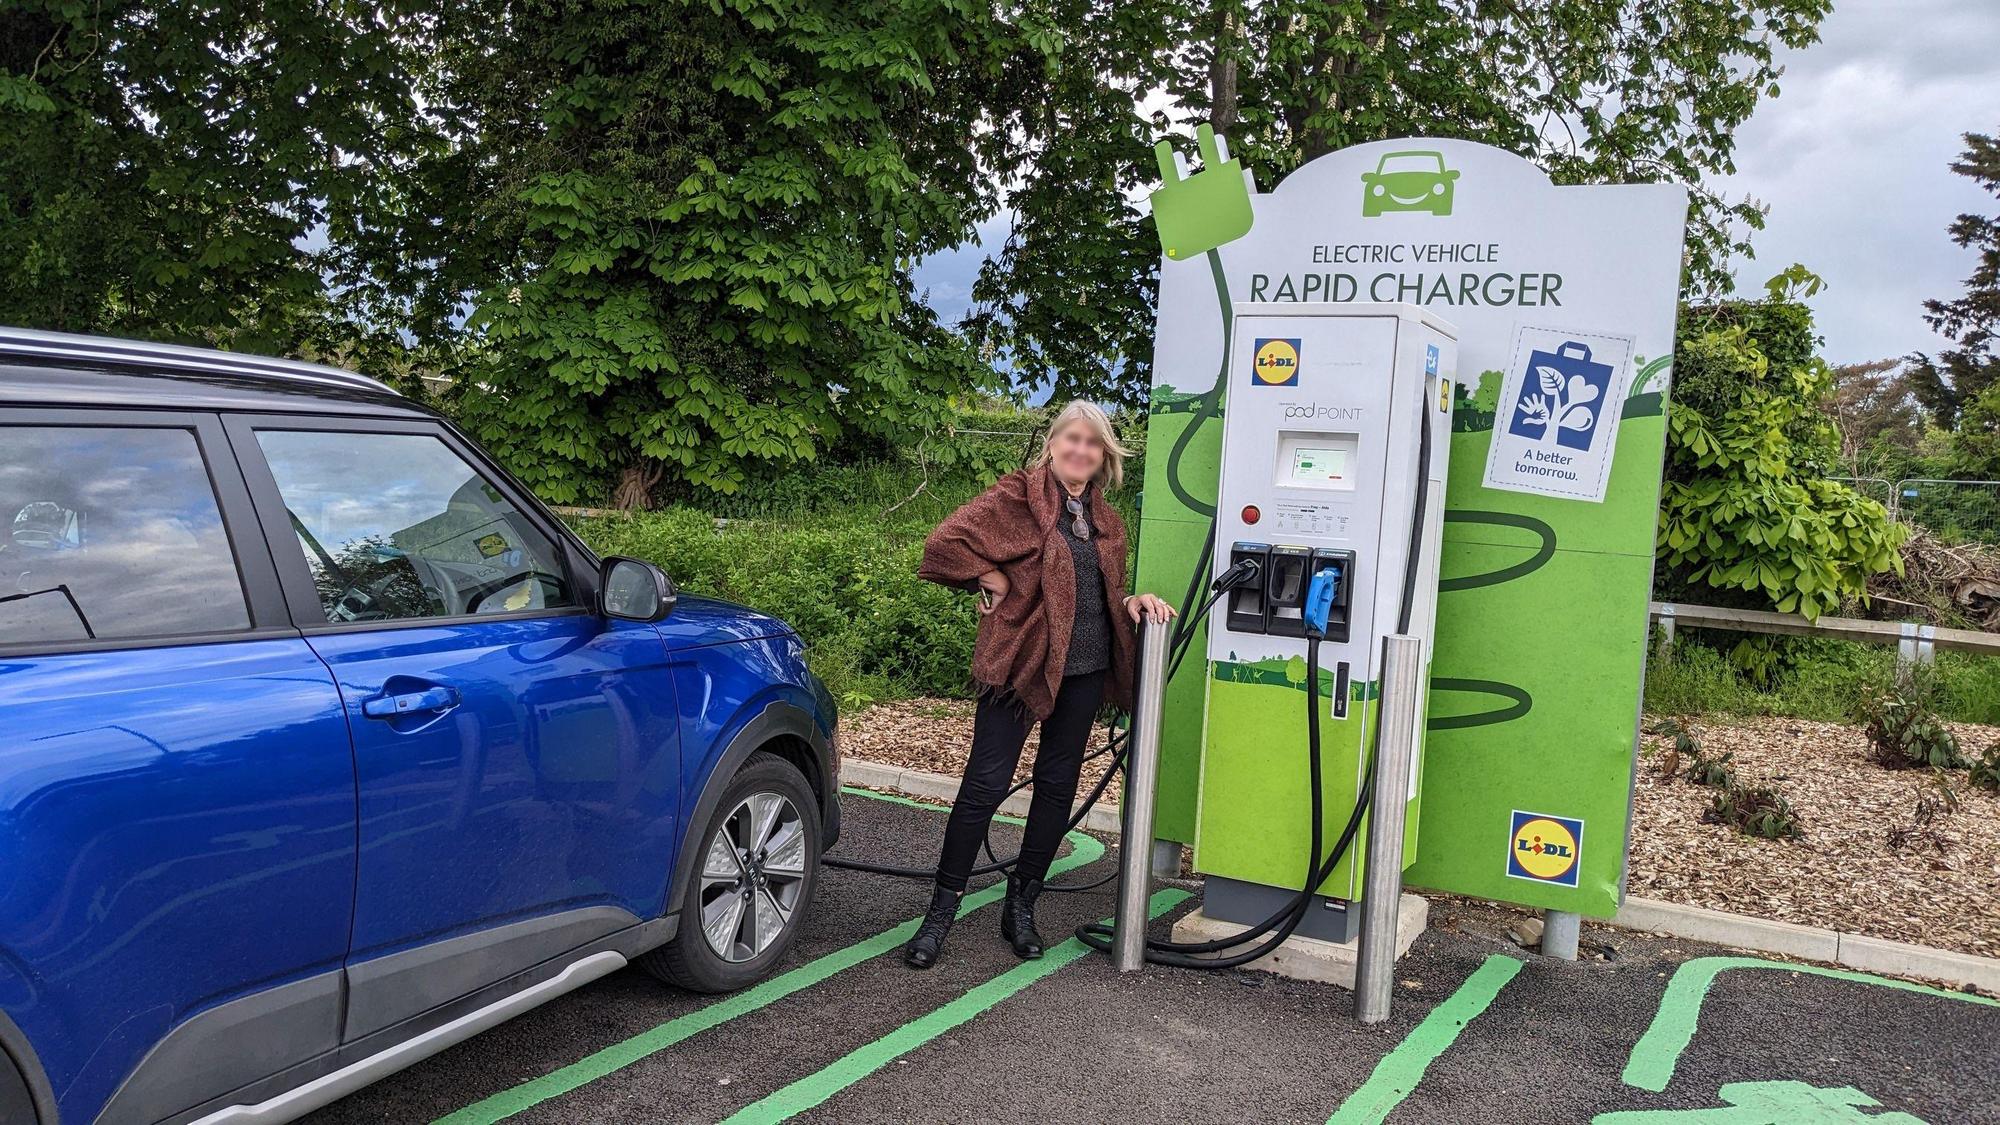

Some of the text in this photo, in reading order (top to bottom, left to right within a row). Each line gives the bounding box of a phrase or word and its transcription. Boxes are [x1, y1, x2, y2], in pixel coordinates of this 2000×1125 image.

[1312, 244, 1499, 263] ELECTRIC VEHICLE
[1250, 272, 1563, 307] RAPID CHARGER
[1284, 402, 1363, 422] pod POINT
[1523, 449, 1573, 465] A better
[1515, 461, 1578, 481] tomorrow.
